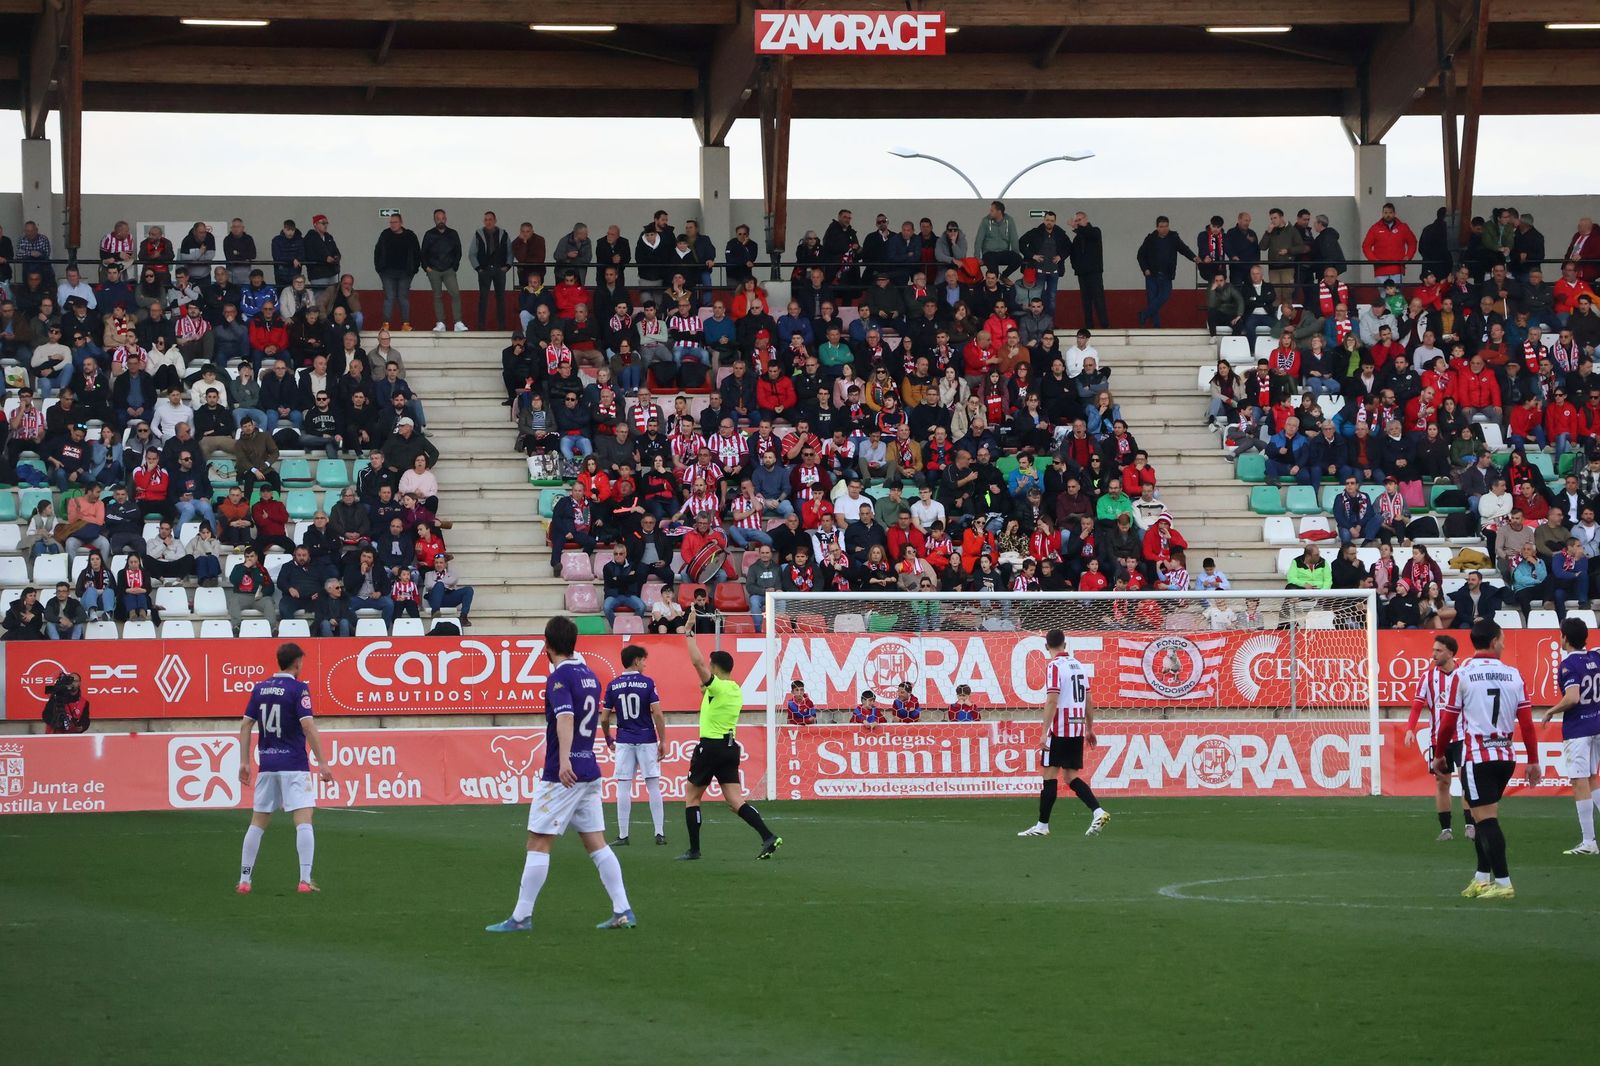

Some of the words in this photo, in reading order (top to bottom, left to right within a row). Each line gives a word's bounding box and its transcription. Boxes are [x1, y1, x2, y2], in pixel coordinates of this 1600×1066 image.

[1156, 639, 1188, 648] FONDO
[222, 662, 264, 678] Grupo
[1253, 658, 1380, 681] CENTRO
[259, 687, 285, 696] TAVARES
[357, 690, 472, 703] EMBUTIDOS
[481, 691, 489, 700] Y
[612, 681, 627, 691] DAVID
[628, 681, 647, 689] AMIGO
[1071, 674, 1085, 703] 16
[1151, 681, 1196, 694] MODORRO
[579, 695, 595, 737] 2
[618, 693, 640, 720] 10
[1487, 688, 1501, 729] 7
[259, 704, 282, 738] 14
[853, 733, 935, 749] bodegas
[997, 730, 1025, 744] del
[328, 740, 396, 767] Joven
[817, 737, 1042, 776] Sumiller
[1090, 735, 1306, 788] ZAMORA
[29, 781, 78, 795] Junta
[83, 780, 105, 793] de
[346, 779, 359, 807] y
[365, 772, 421, 799] León
[50, 803, 58, 813] y
[63, 797, 105, 811] León
